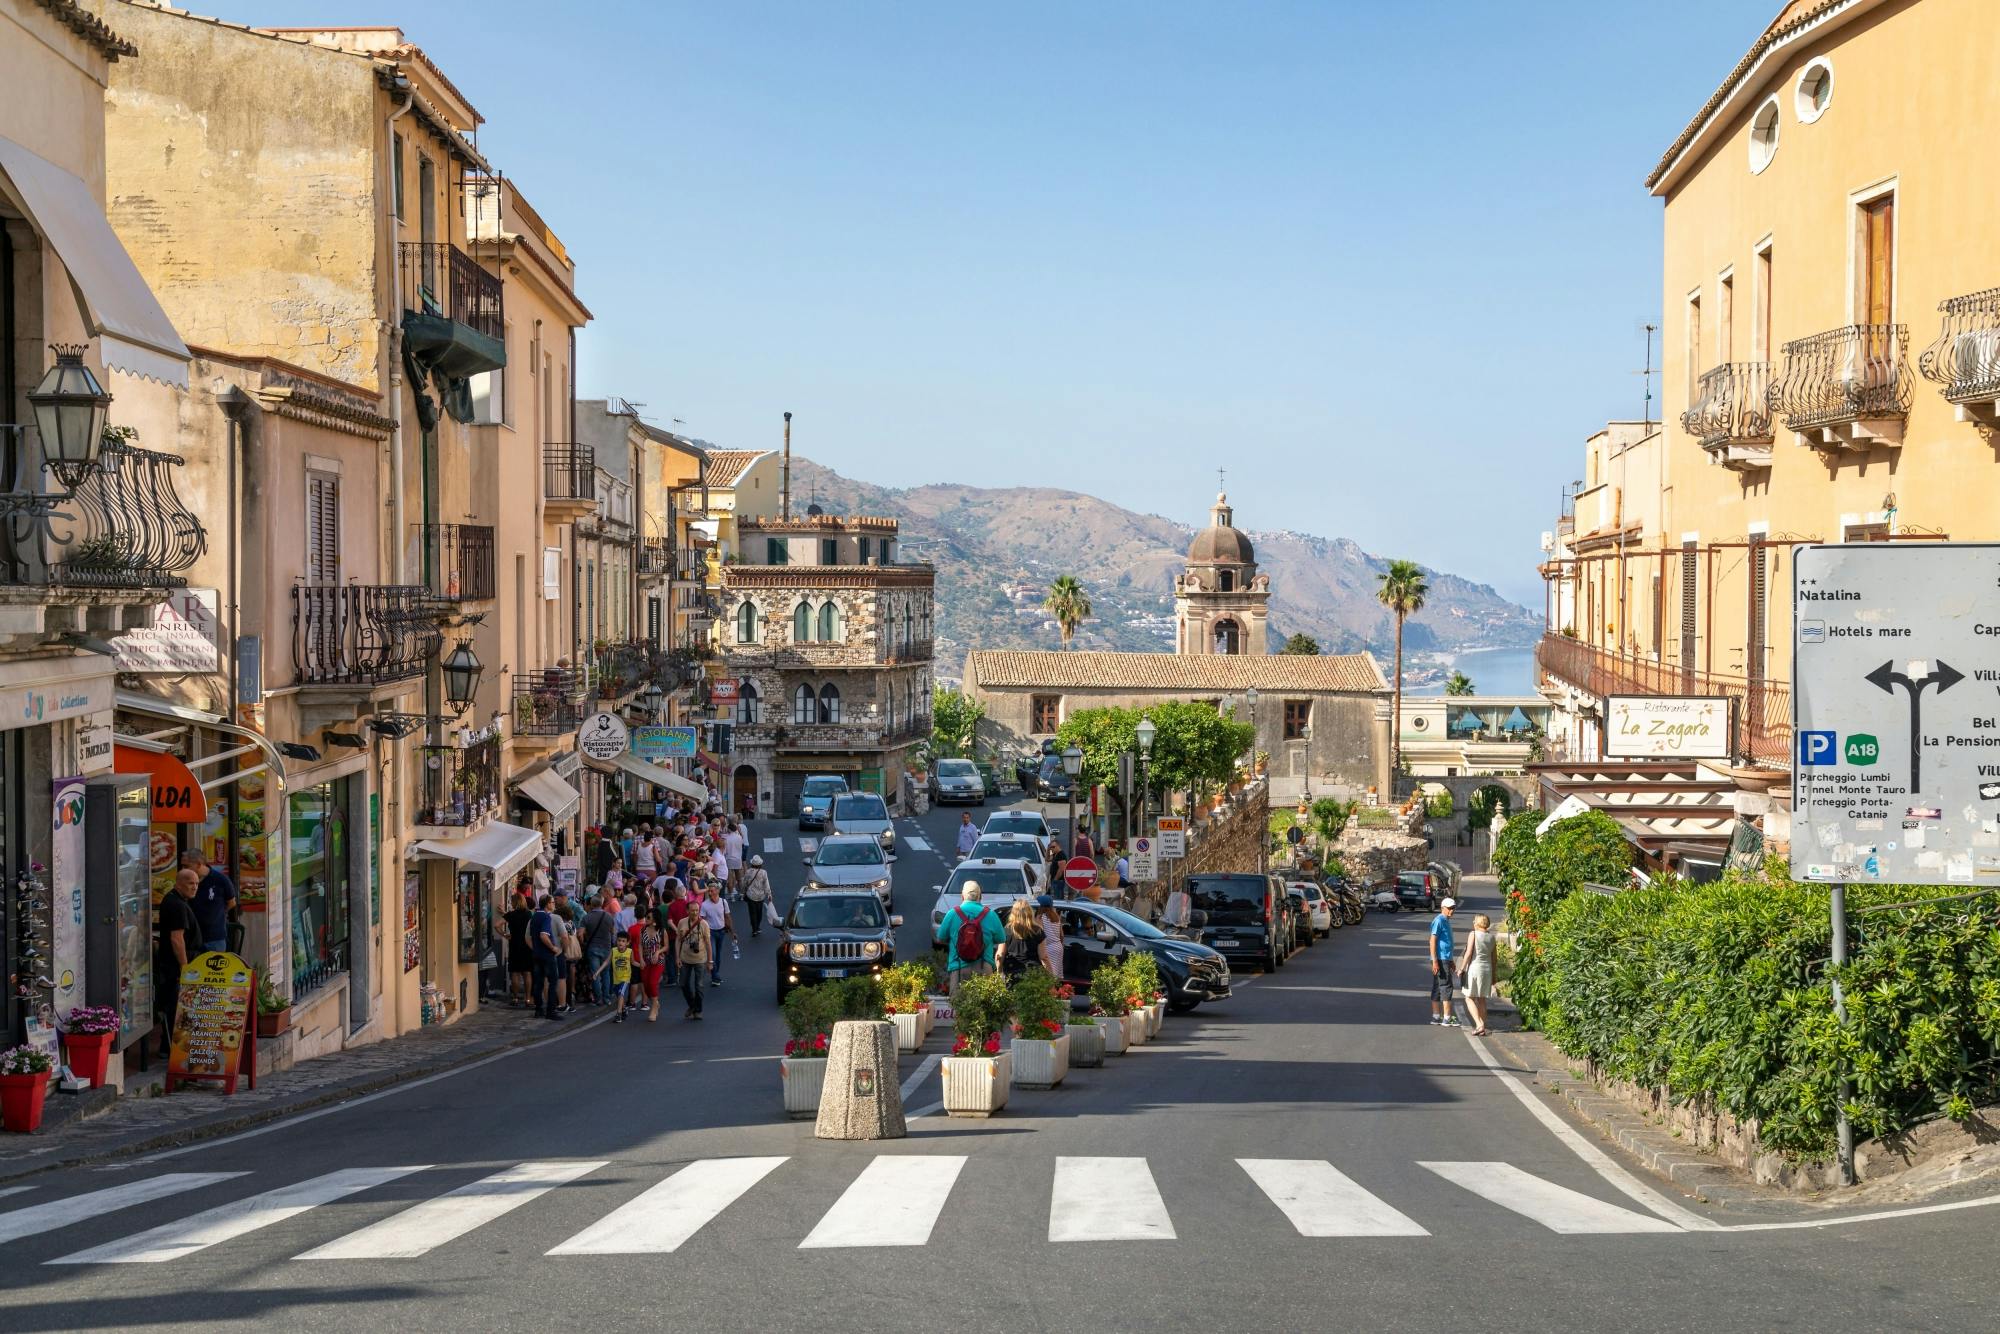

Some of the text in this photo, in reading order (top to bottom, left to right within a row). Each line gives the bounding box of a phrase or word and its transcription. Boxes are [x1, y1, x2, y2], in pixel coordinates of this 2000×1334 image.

[1800, 589, 1861, 601] Natalina
[153, 596, 208, 622] AR
[1829, 626, 1912, 637] Hotels mare
[1643, 702, 1691, 713] Ristorante
[1973, 717, 1996, 728] Bel
[1621, 714, 1710, 749] La Zagara
[1923, 736, 1939, 746] La
[1808, 734, 1877, 762] P A18
[1800, 773, 1890, 784] Parcheggio Lumbi
[1800, 786, 1906, 794] Tnnel Monte Tauro
[1800, 798, 1856, 809] Prcheggio
[1848, 810, 1888, 819] Catania
[1160, 821, 1181, 830] TAXI
[189, 1057, 216, 1065] BEVANDE
